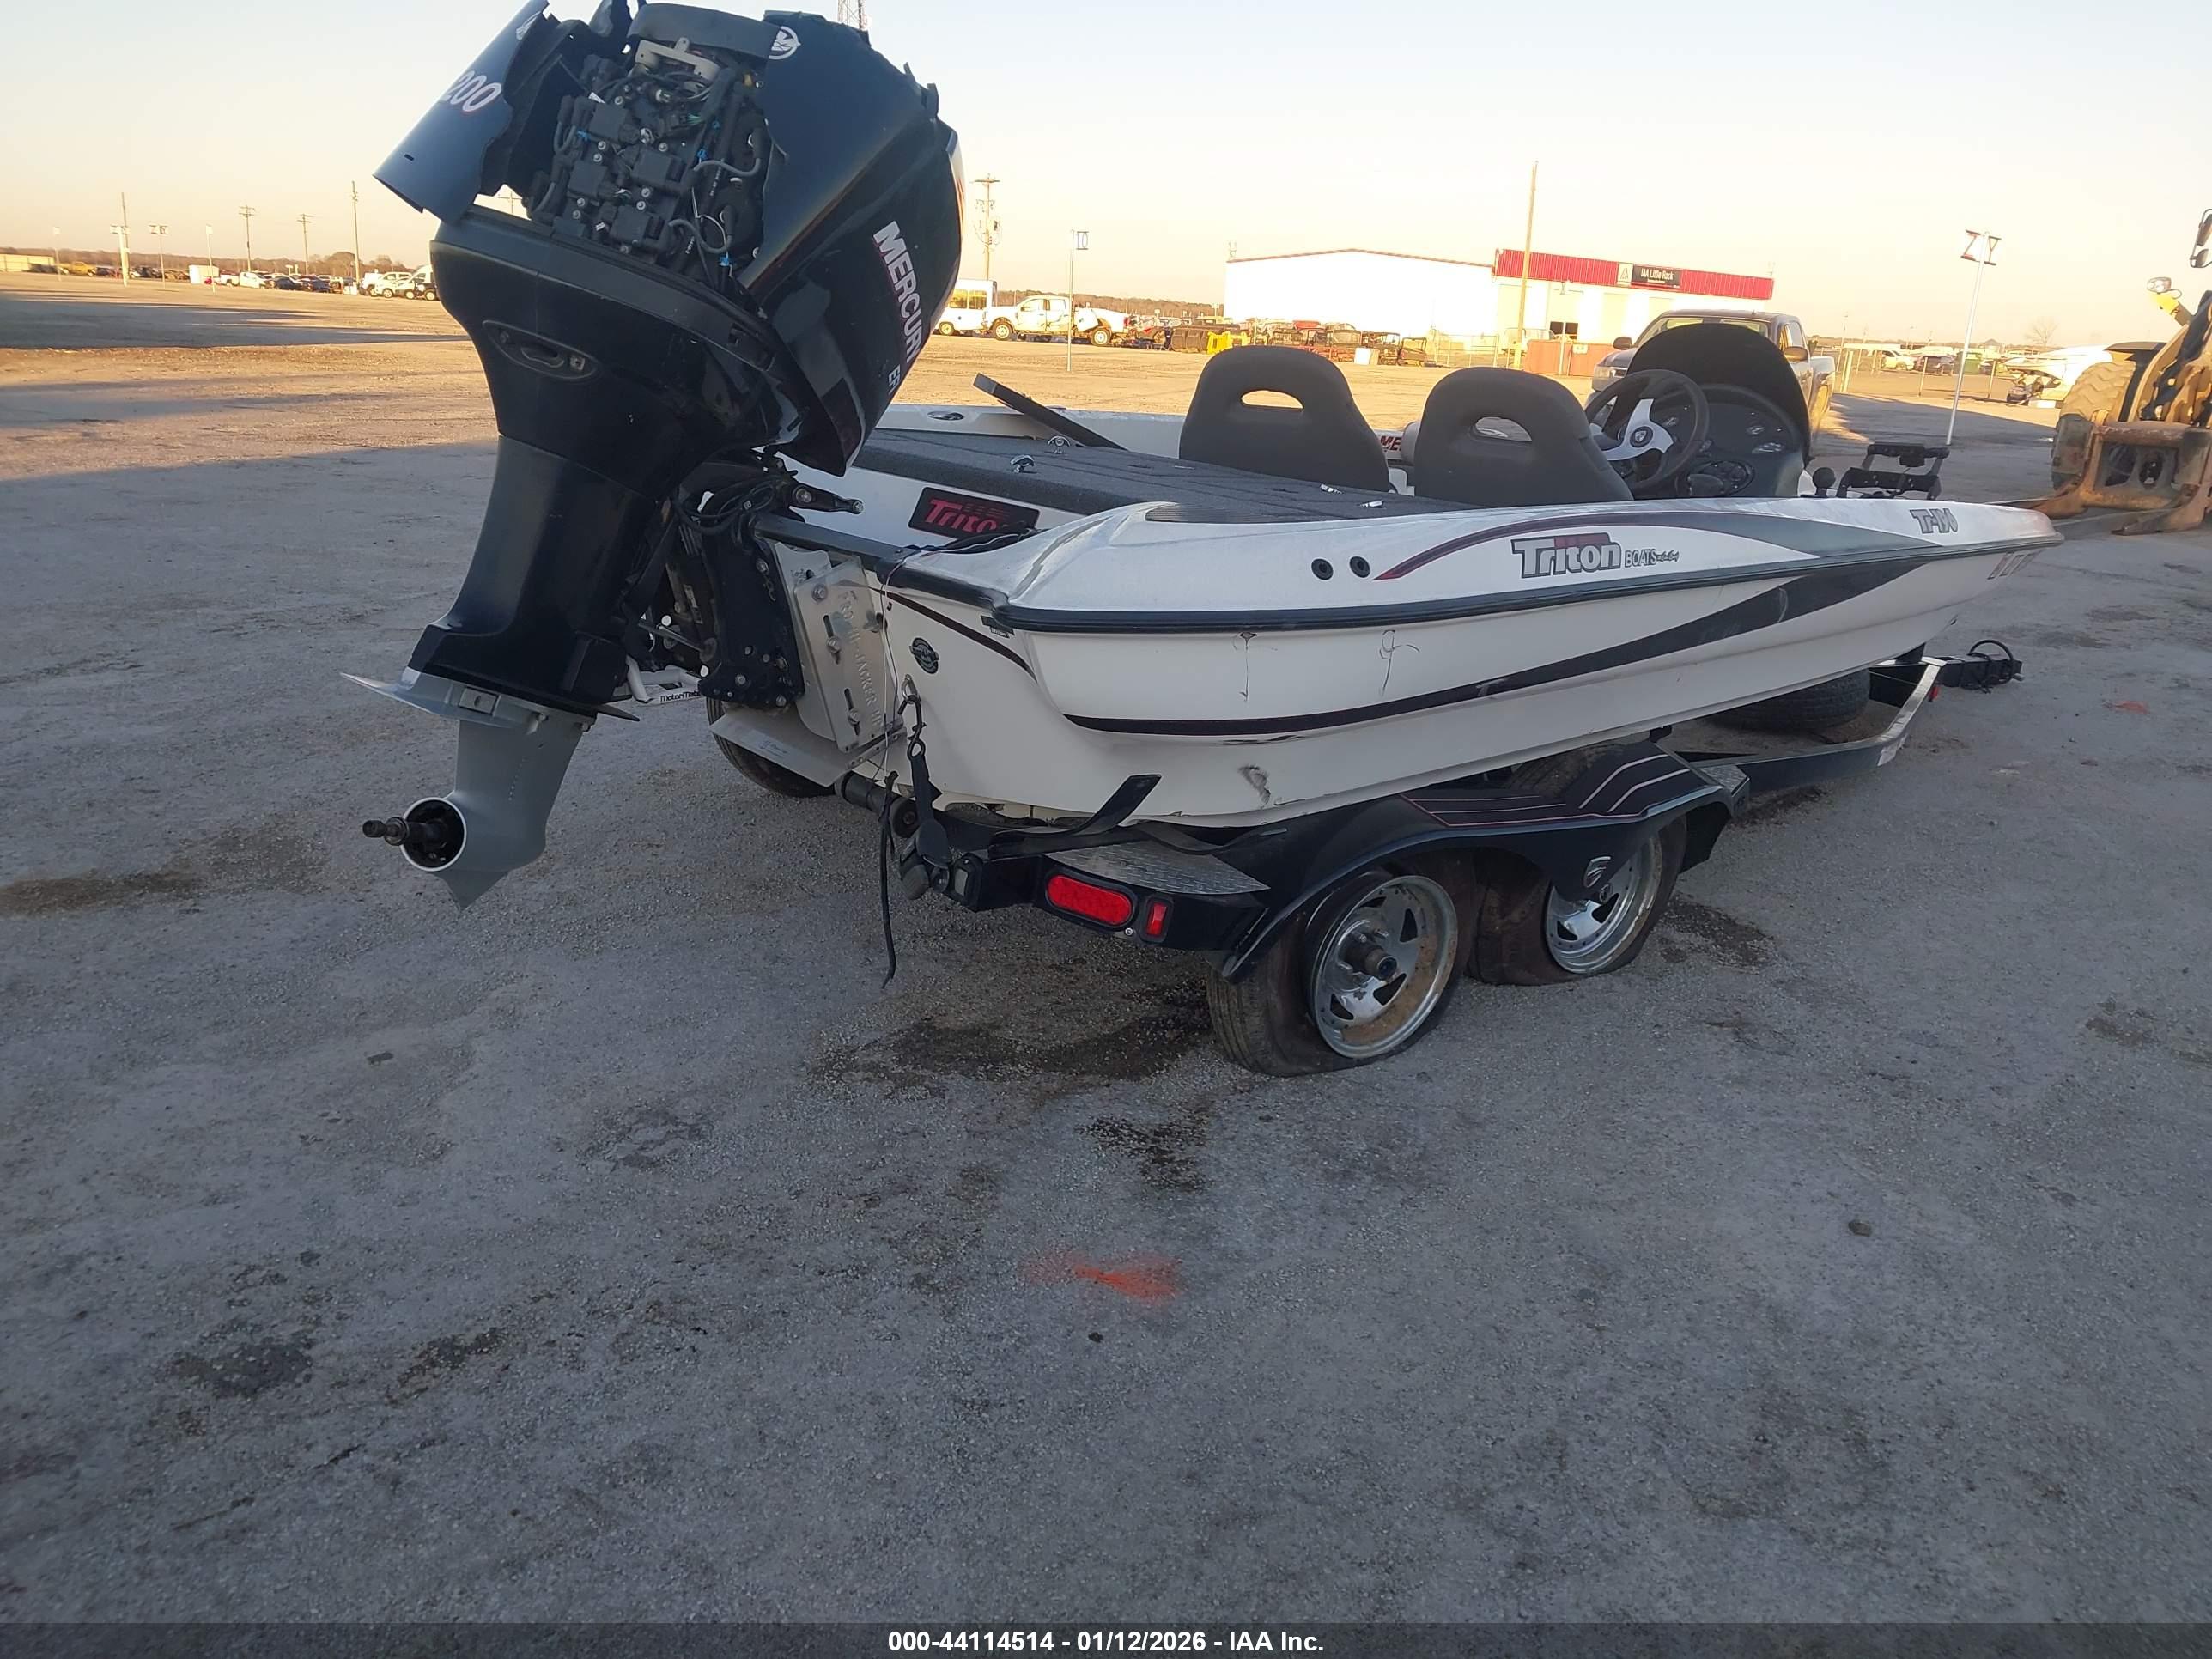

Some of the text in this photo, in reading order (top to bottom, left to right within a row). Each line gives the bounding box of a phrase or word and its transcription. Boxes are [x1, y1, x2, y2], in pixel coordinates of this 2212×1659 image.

[873, 220, 923, 363] MERCURY
[925, 498, 1000, 533] Trito
[1511, 532, 1621, 579] Triton
[1625, 548, 1656, 568] BOATS
